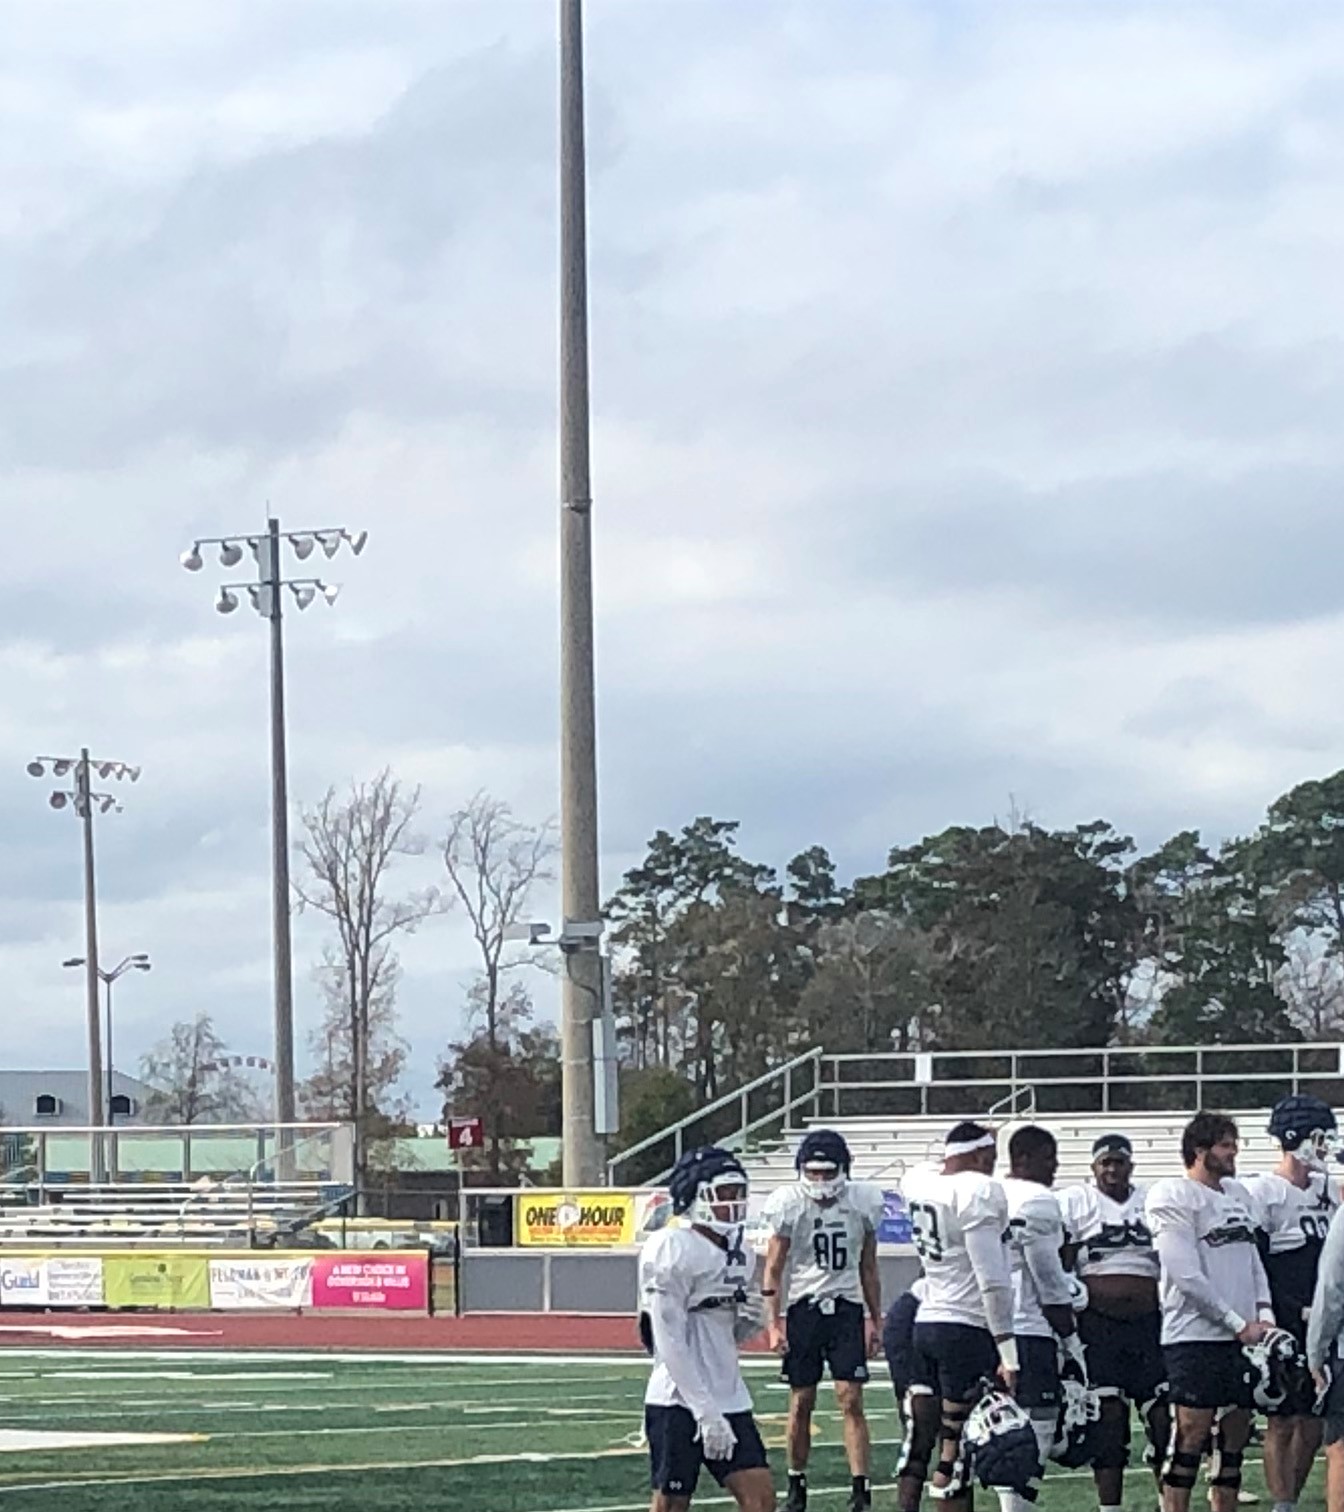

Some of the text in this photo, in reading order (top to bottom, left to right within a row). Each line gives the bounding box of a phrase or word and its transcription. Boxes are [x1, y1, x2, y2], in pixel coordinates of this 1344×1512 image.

[459, 1127, 473, 1146] 4
[526, 1207, 625, 1227] ONE HOUR
